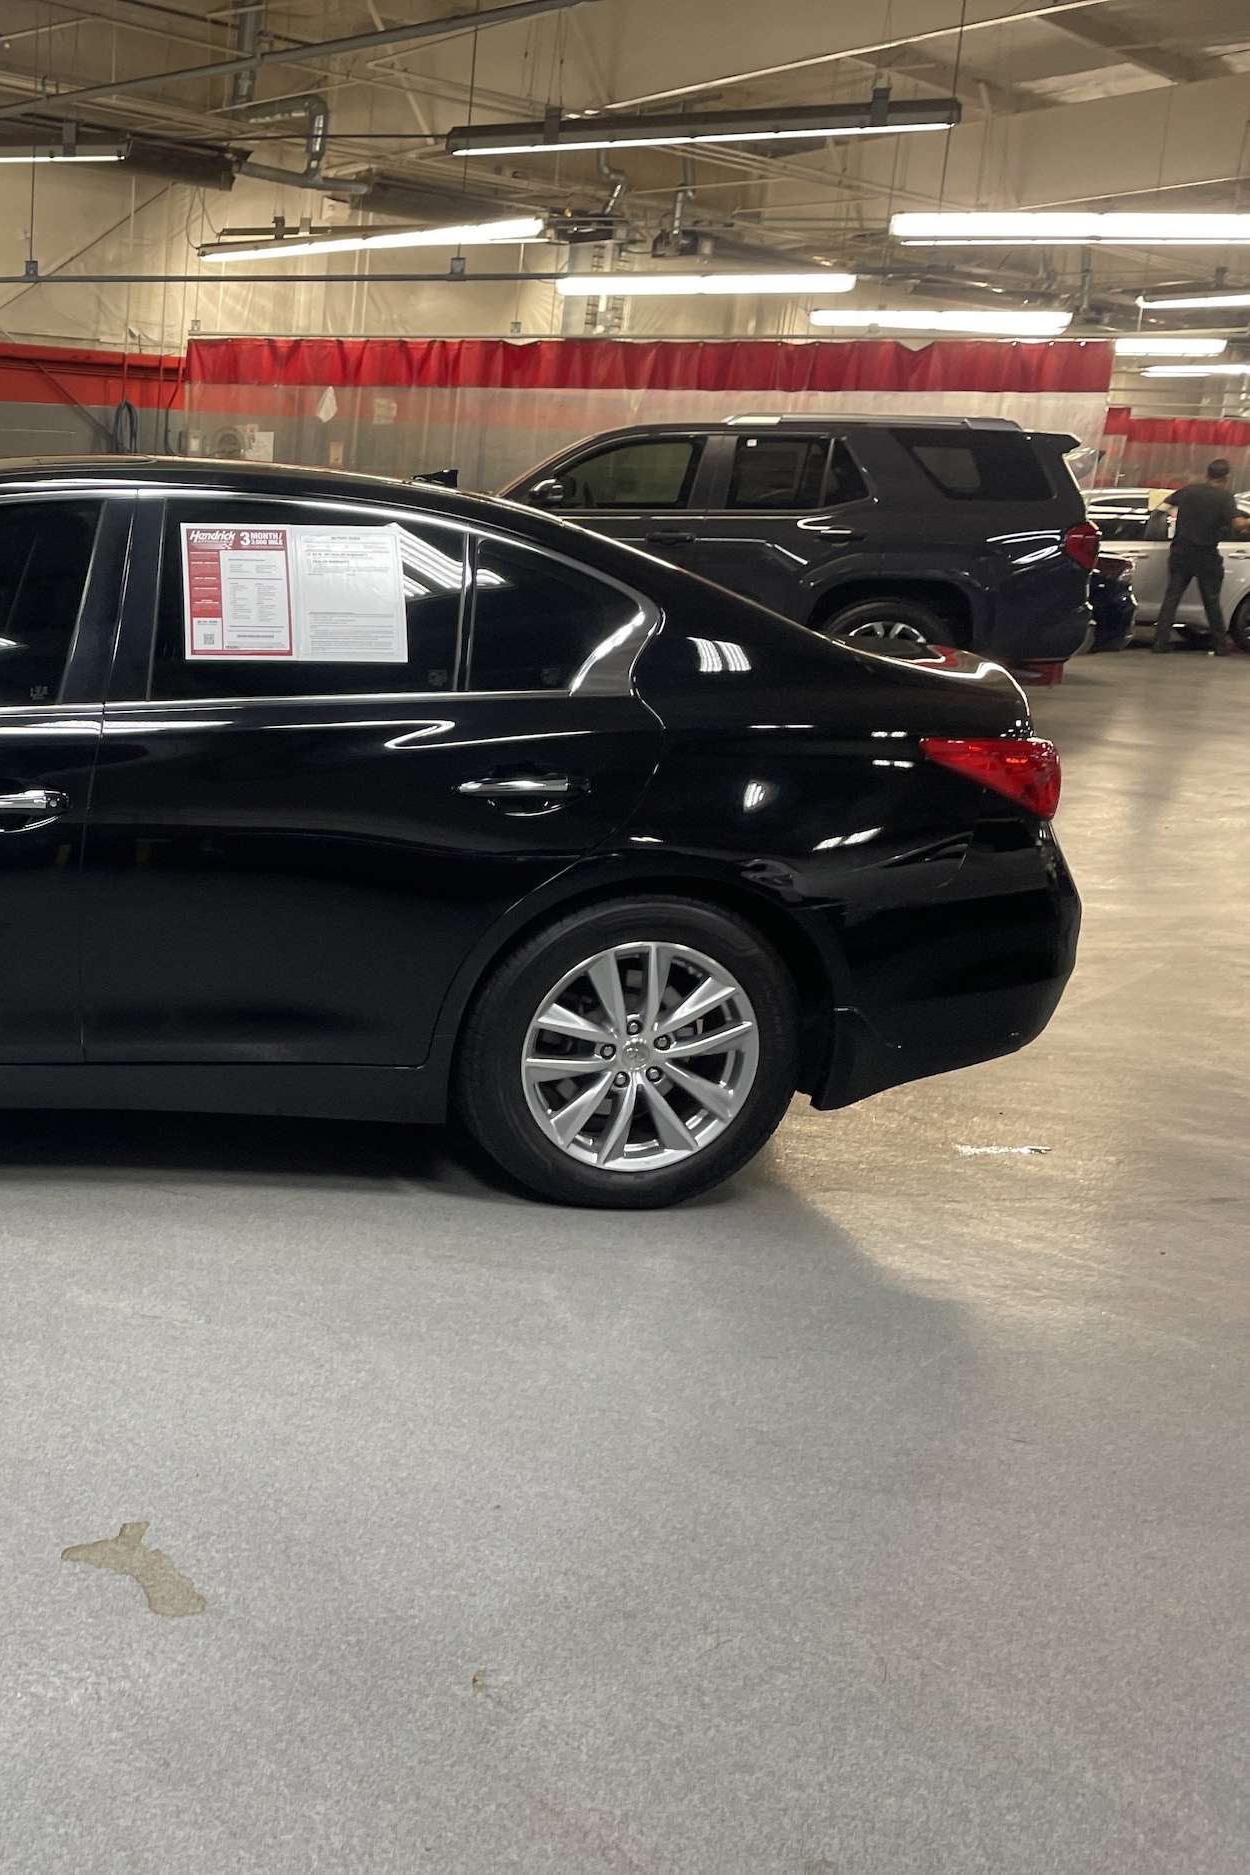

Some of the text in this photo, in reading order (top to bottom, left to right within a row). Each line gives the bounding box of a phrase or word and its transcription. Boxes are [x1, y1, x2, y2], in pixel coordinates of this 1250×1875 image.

[189, 530, 236, 543] Hendrick
[240, 531, 283, 546] 3 MONTH/
